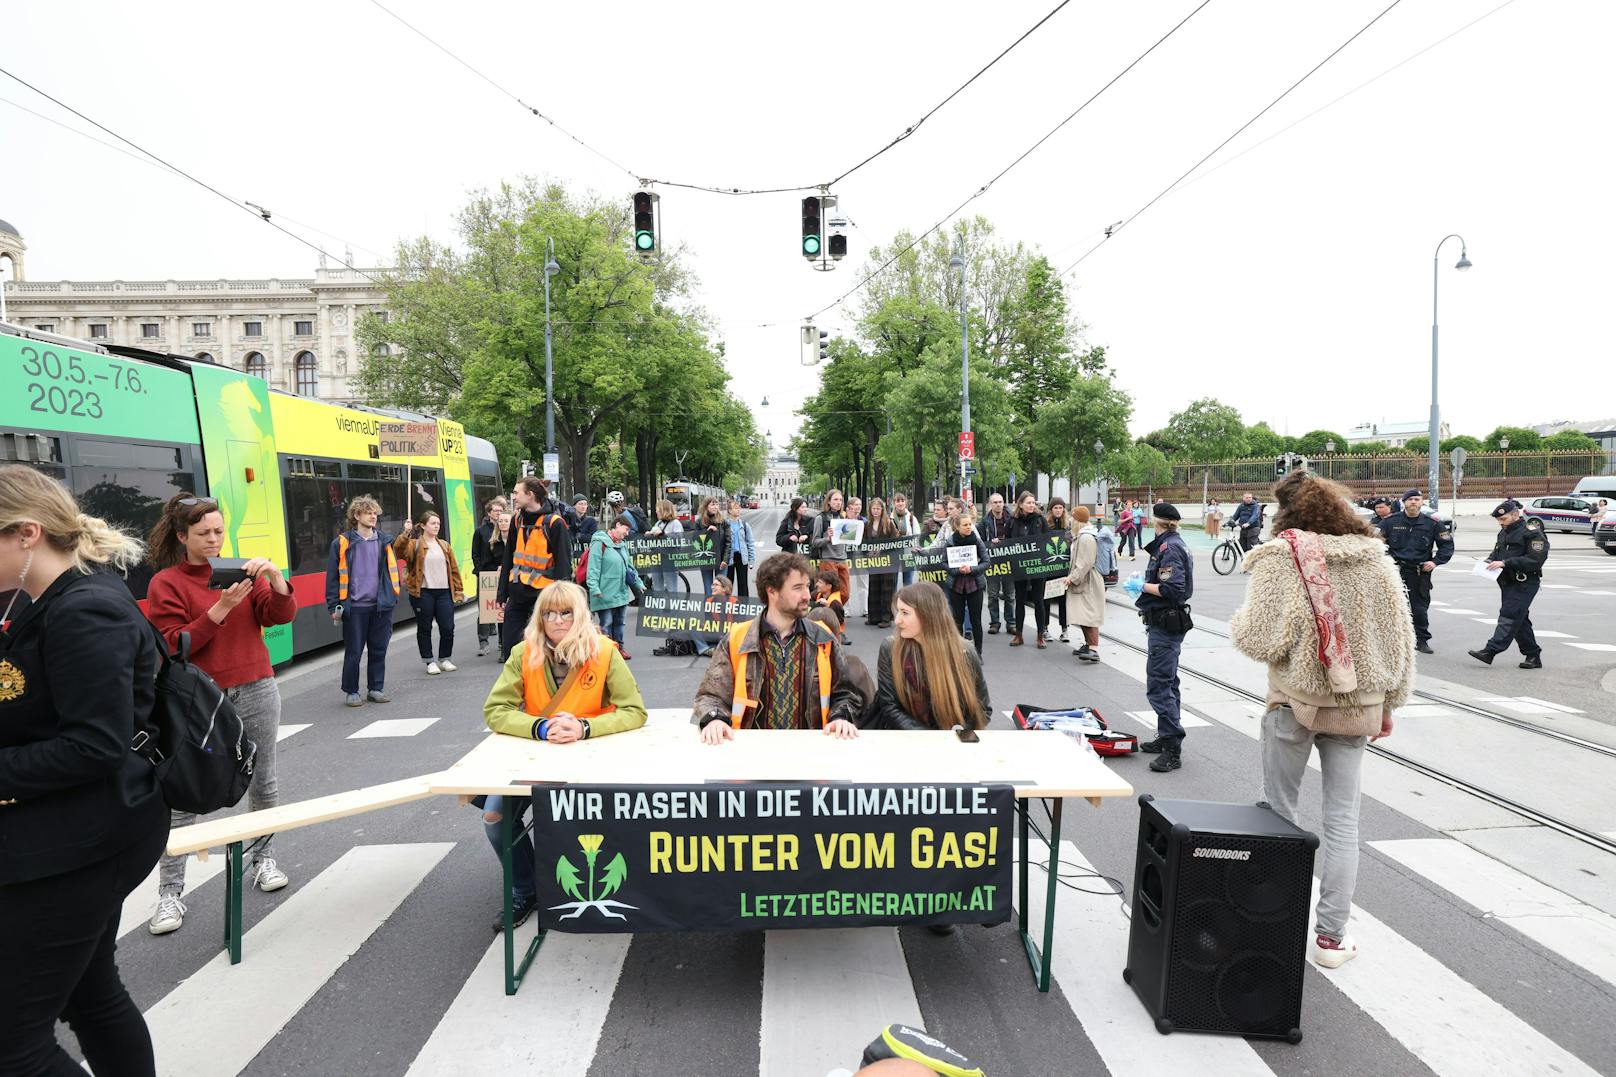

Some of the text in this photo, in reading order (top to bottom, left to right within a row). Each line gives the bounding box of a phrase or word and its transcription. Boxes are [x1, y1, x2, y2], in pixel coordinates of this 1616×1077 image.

[28, 383, 103, 419] 2023
[381, 424, 405, 433] ERDE
[380, 440, 417, 453] POLITIK
[637, 553, 662, 567] GAS!
[855, 555, 892, 569] GENUG!
[1018, 558, 1042, 568] LETZTE
[644, 595, 666, 610] UND
[669, 598, 702, 612] WENN
[704, 601, 722, 614] DIE
[642, 615, 686, 631] KEINEN
[688, 617, 721, 634] PLAN
[549, 785, 998, 822] WIR RASEN IN DIE KLIMAHÖLLE.
[649, 826, 998, 875] RUNTER VOM GAS!
[1192, 847, 1251, 861] SOUNDBOKS
[740, 885, 997, 918] LETZTEGENERATION.AT
